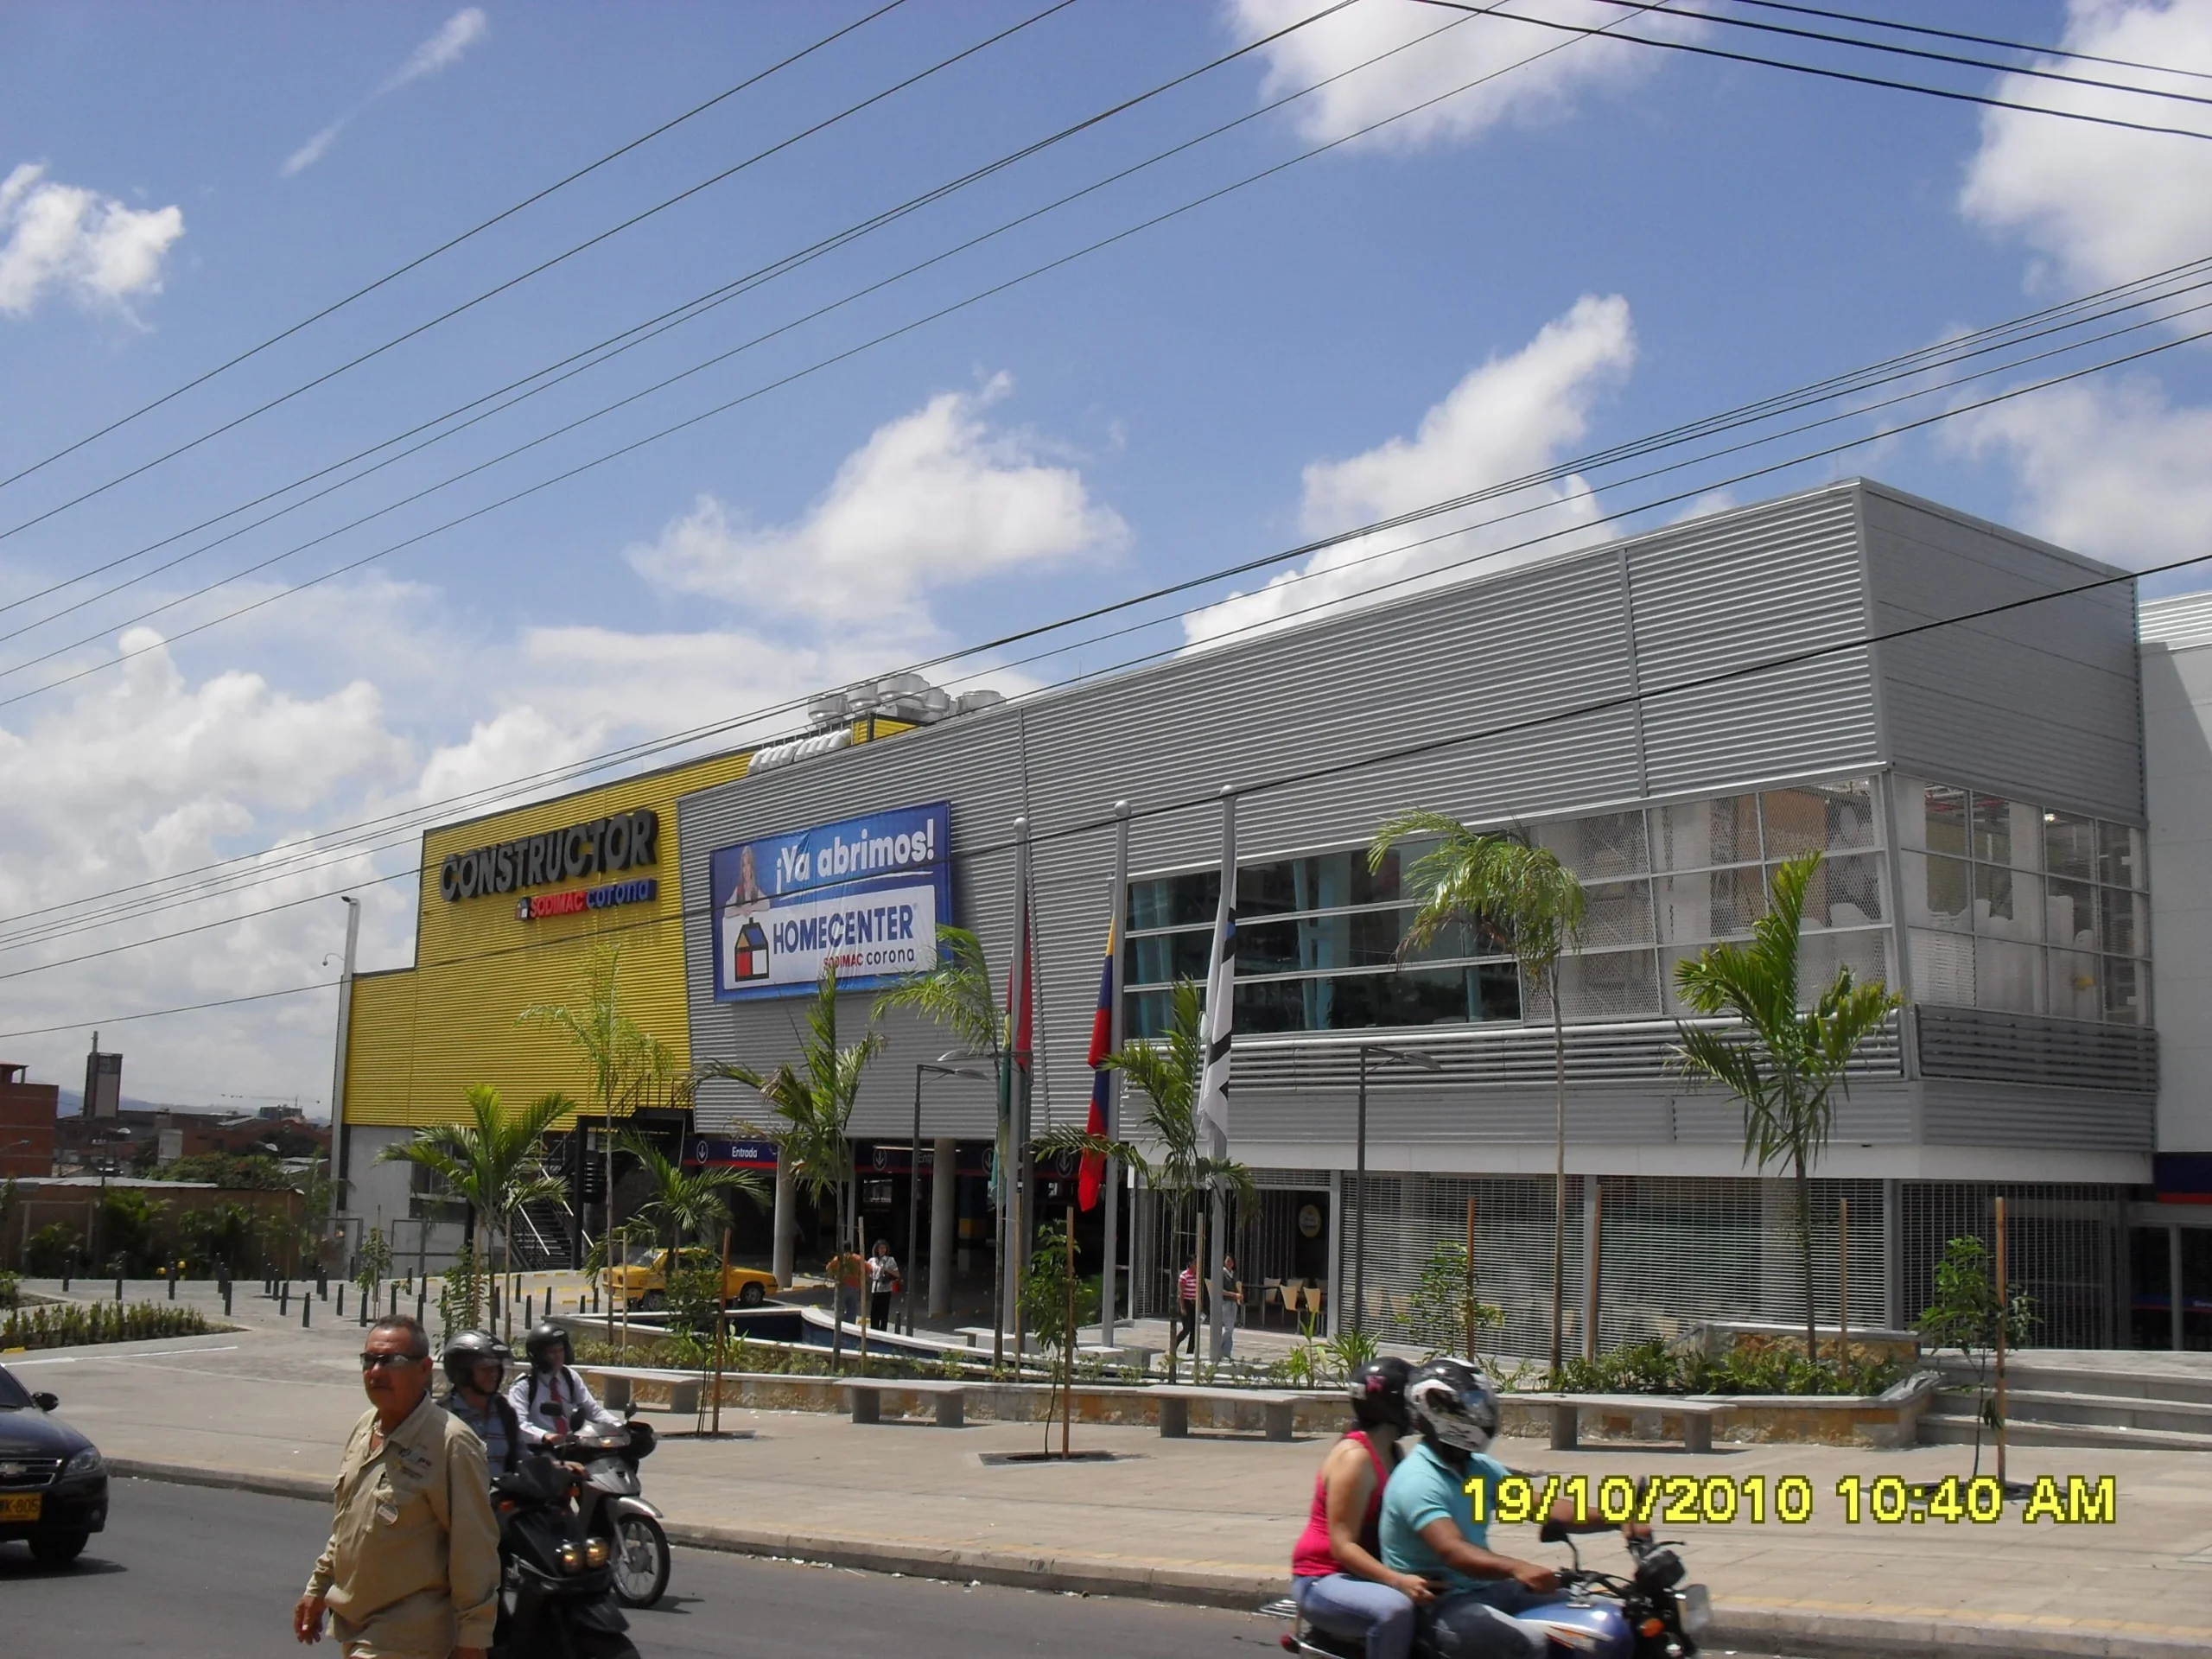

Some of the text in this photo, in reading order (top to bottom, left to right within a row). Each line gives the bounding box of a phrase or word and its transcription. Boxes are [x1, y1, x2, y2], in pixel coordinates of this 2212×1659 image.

[441, 809, 658, 901] CONSTRUCTOR
[817, 818, 935, 878] abrimos!
[529, 880, 650, 918] SODIMAC corona
[773, 905, 914, 955] HOMECENTER
[823, 948, 915, 969] SODIMAC corona
[731, 1146, 758, 1158] Entrada
